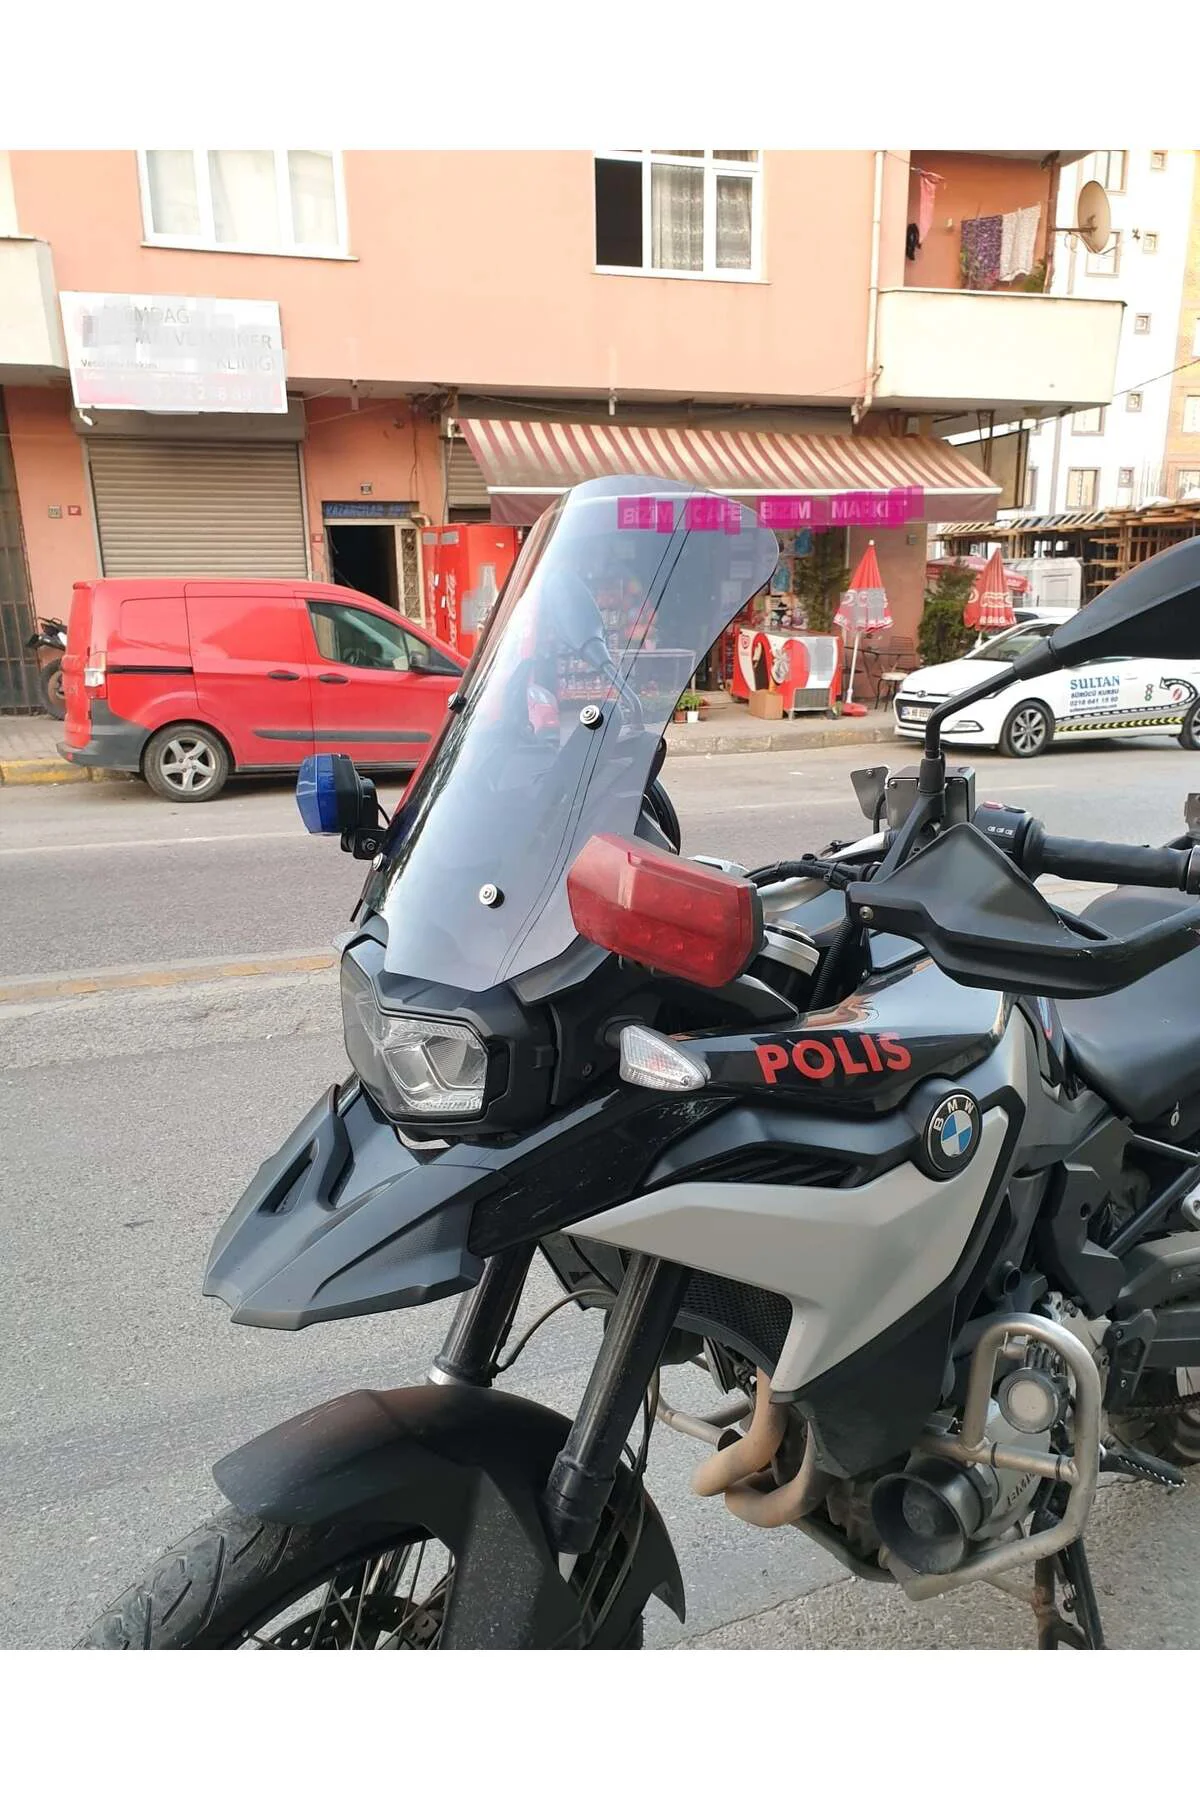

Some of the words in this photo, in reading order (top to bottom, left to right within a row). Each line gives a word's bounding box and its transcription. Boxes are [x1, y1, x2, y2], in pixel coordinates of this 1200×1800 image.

[831, 498, 908, 520] MARKET
[1070, 675, 1120, 690] SULTAN
[933, 1098, 974, 1132] BMW
